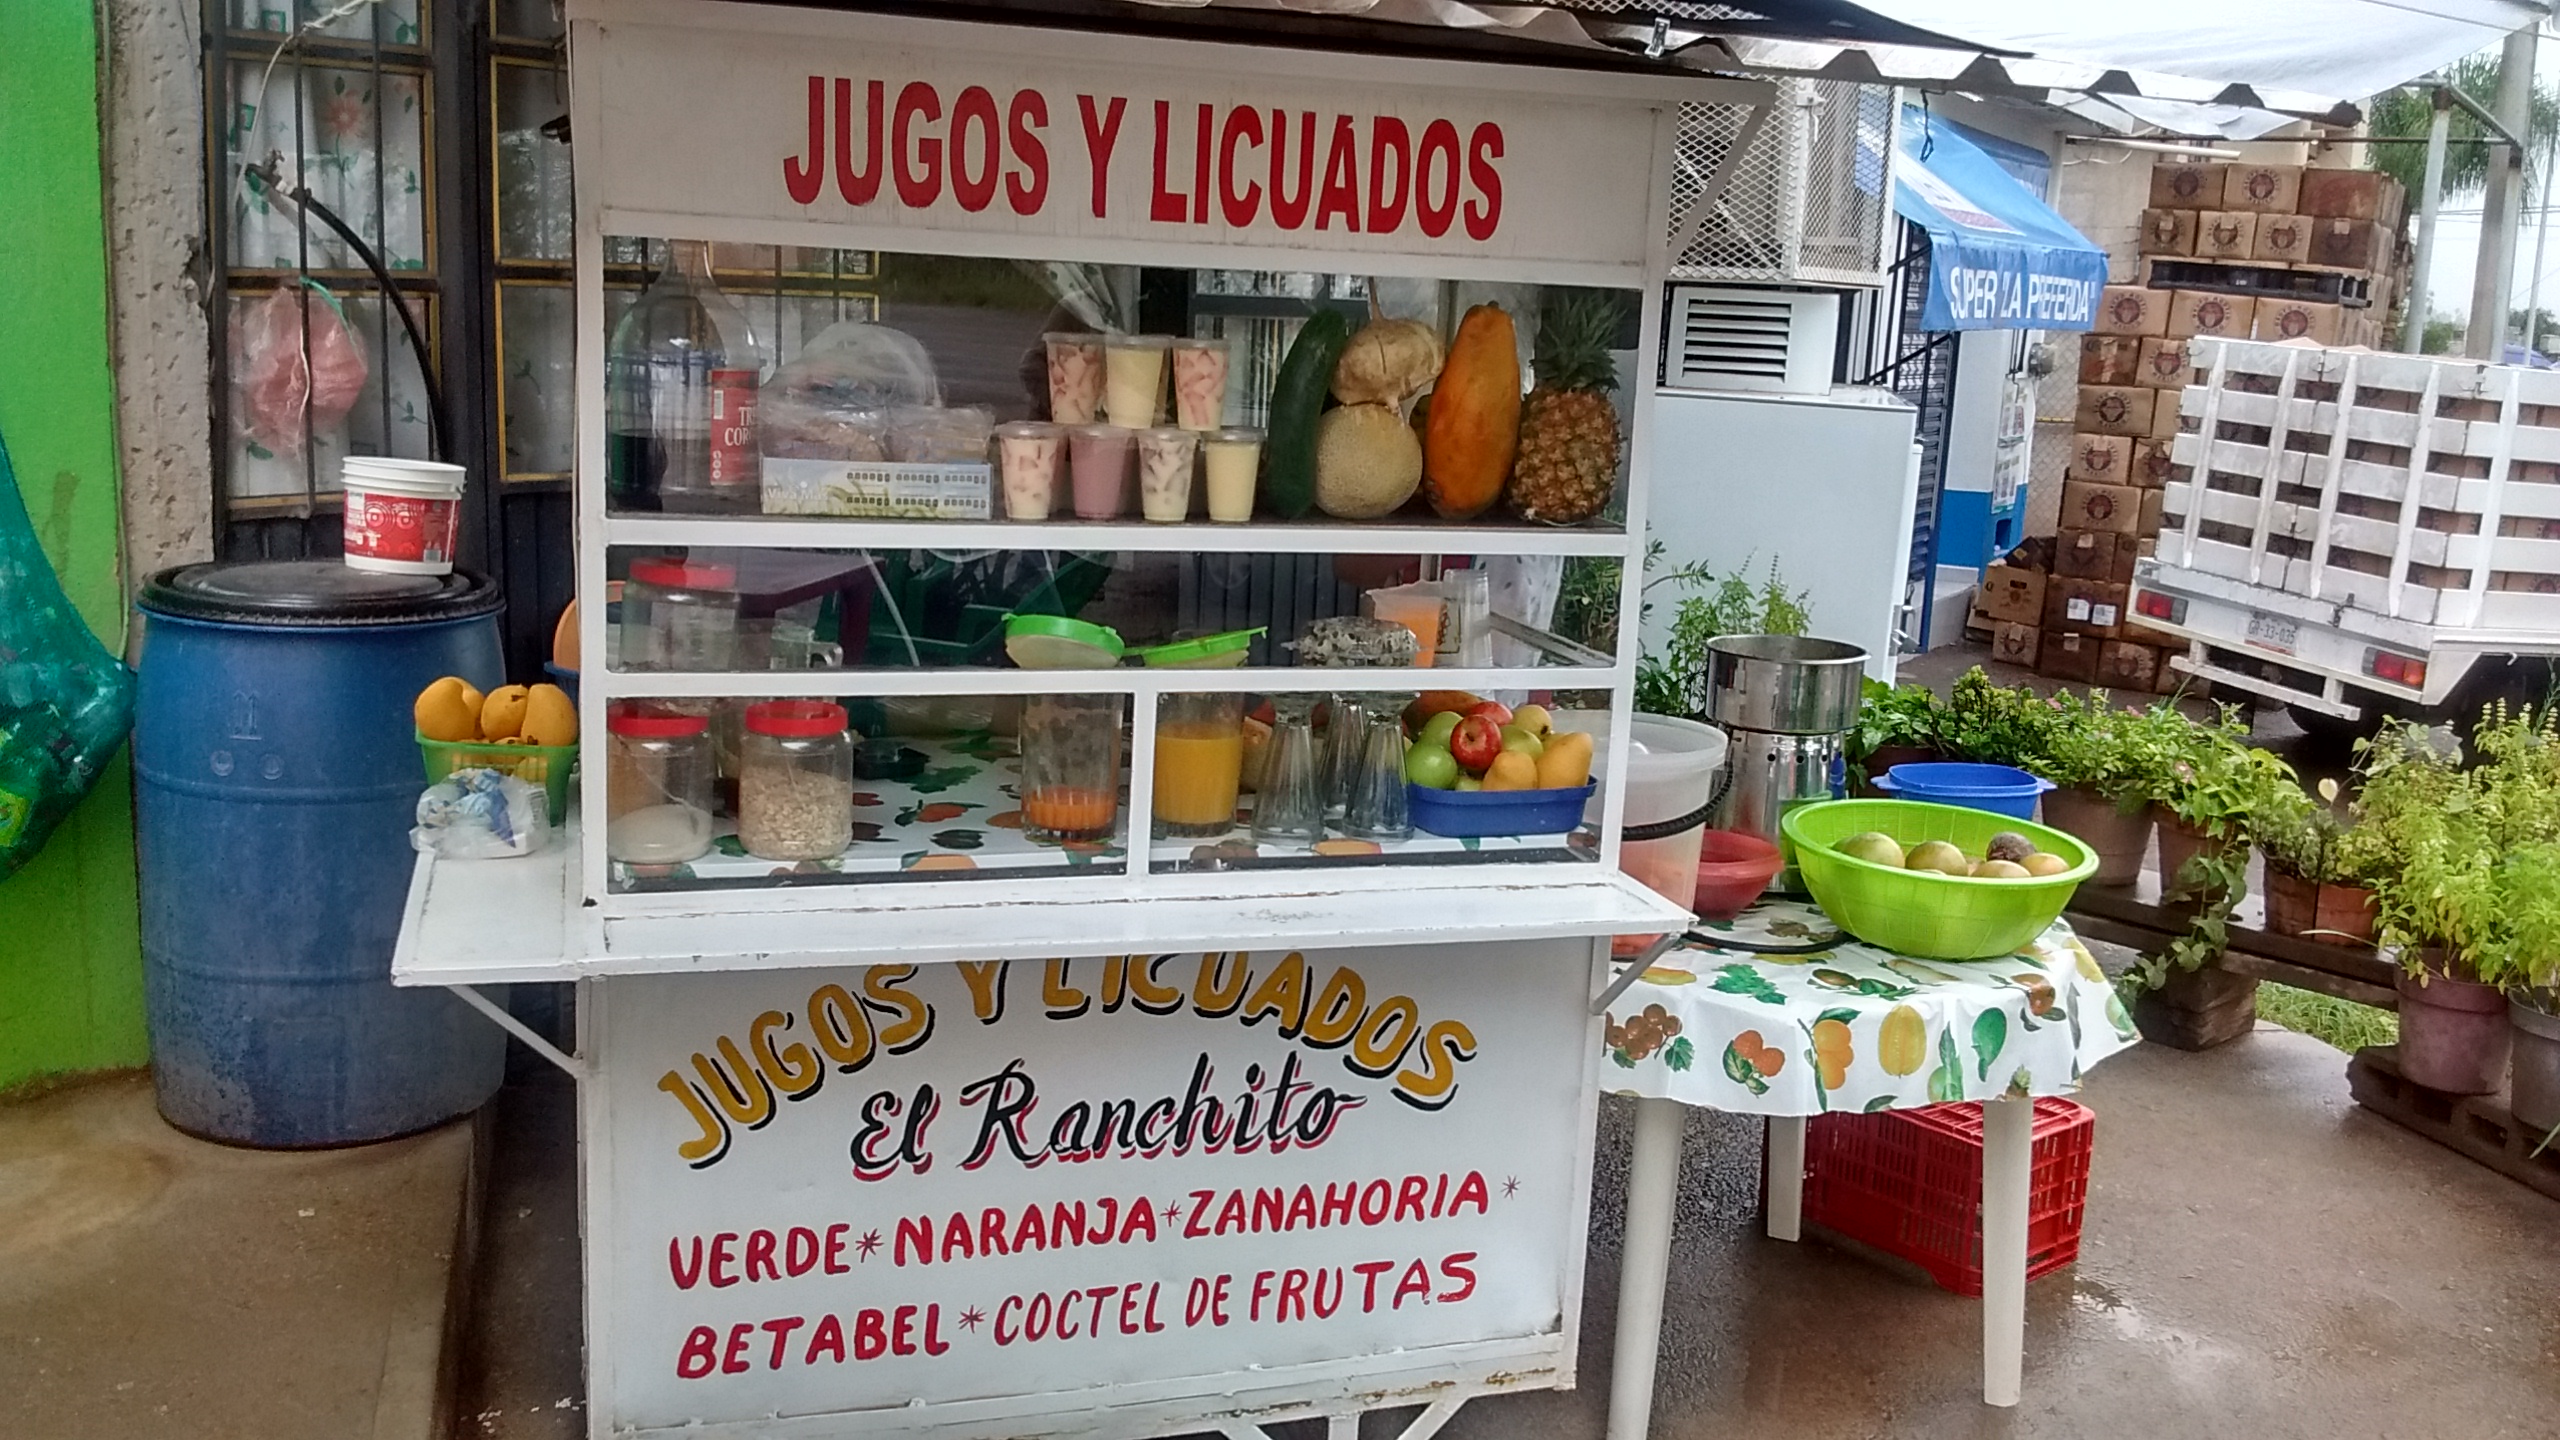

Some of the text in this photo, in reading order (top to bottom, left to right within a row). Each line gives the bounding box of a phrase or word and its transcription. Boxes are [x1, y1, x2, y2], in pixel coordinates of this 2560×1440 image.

[783, 75, 1505, 241] JUGOS Y LICUADOS
[1950, 266, 1998, 319] SUPER
[658, 951, 1478, 1170] JUGOS Y LICUADOS
[849, 1050, 1368, 1182] El Ranchito
[669, 1170, 1490, 1290] VERDE NARANJA ZANAHORIA
[676, 1251, 1478, 1380] BETABEL COCTEL DE FRUTAS
